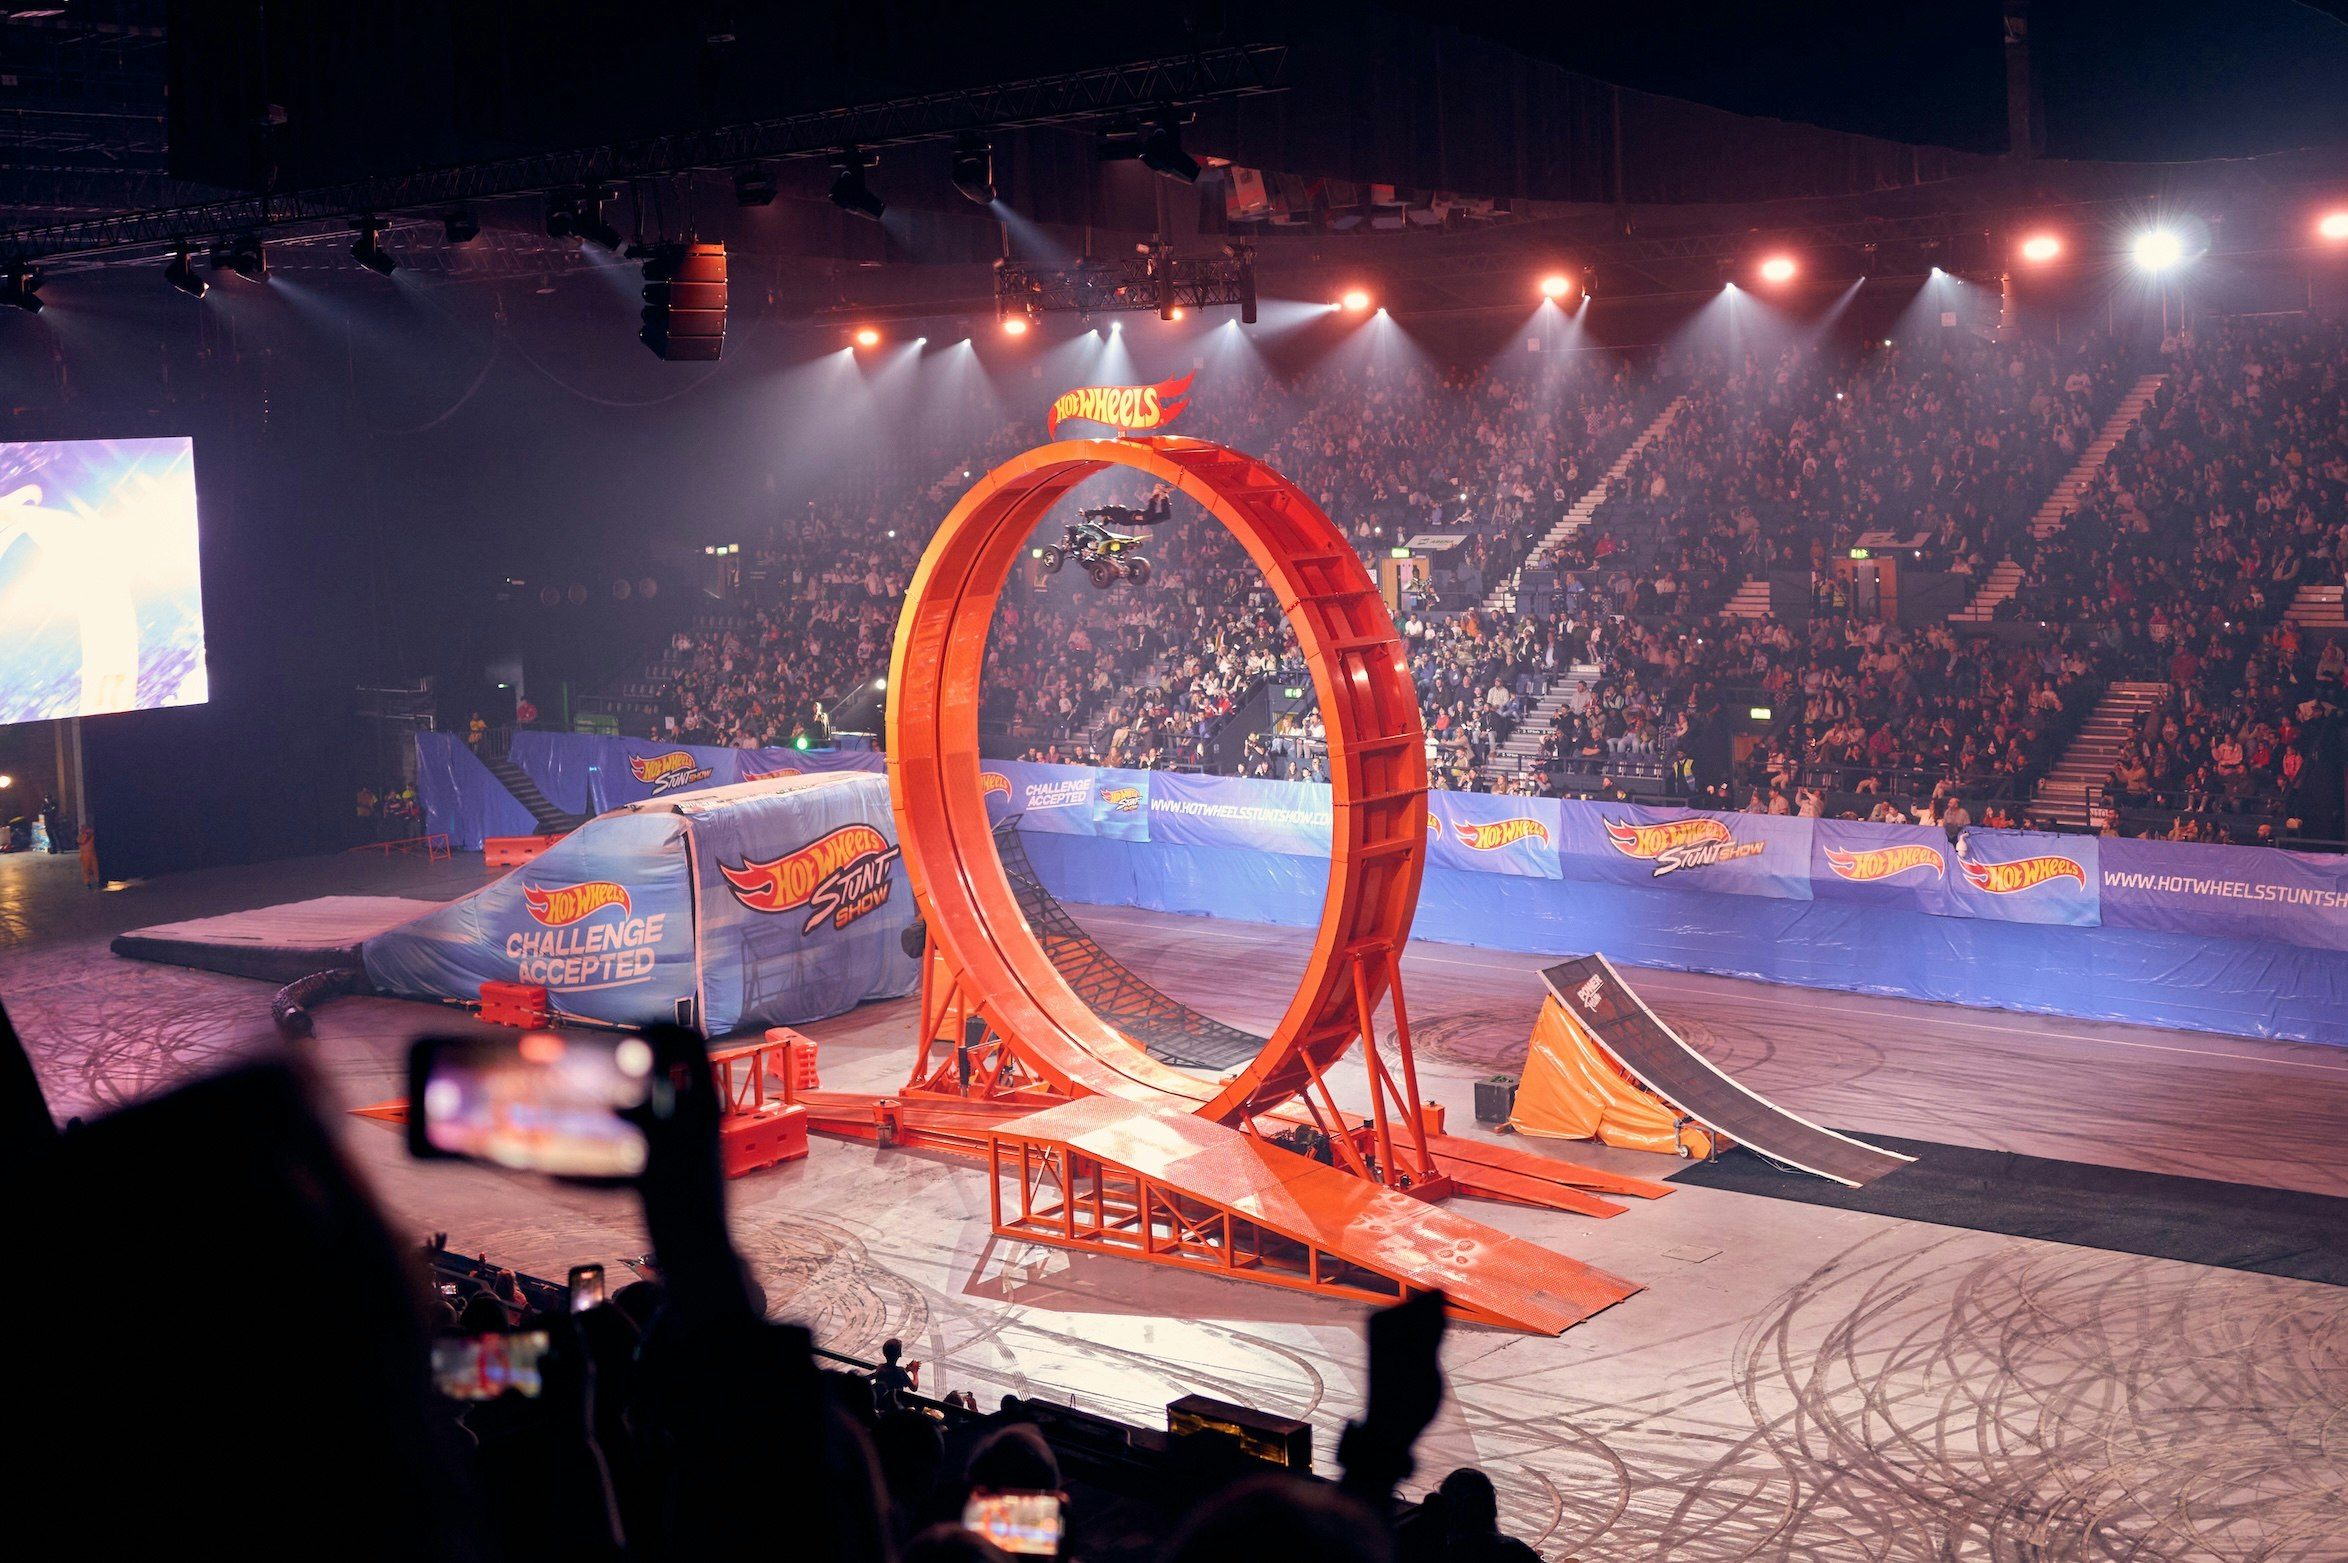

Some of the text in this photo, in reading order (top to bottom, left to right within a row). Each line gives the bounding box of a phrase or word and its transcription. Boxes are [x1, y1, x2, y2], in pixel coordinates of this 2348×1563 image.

[652, 768, 697, 795] STUNT
[1026, 779, 1091, 796] CHALLENGE
[1028, 791, 1087, 807] ACCEPTED
[1654, 841, 1764, 877] STUNT SHOW
[804, 847, 899, 933] STUNT
[836, 883, 888, 928] SHOW
[506, 913, 666, 959] CHALLENGE
[518, 947, 656, 985] ACCEPTED
[1577, 974, 1603, 1002] POWER
